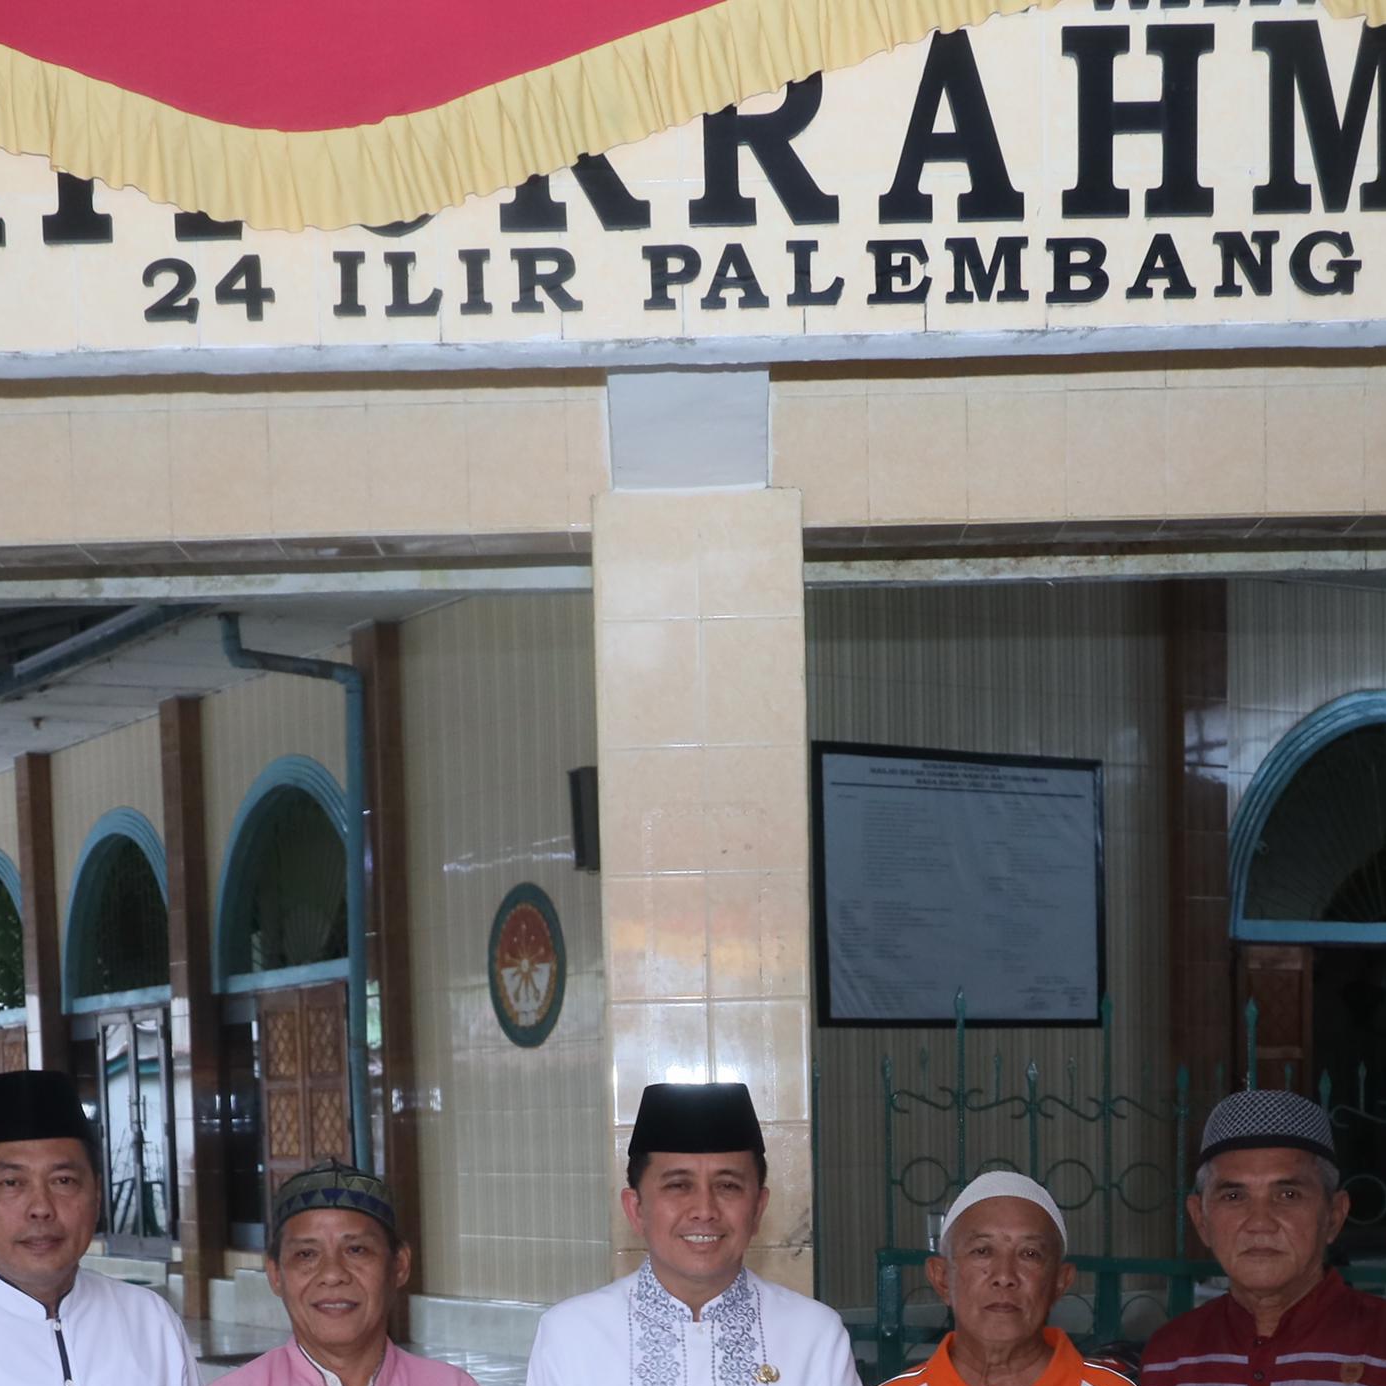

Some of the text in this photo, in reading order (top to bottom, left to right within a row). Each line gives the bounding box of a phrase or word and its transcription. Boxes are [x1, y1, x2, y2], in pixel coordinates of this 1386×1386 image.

[142, 230, 1362, 324] 24 ILIR PALEMBANG
